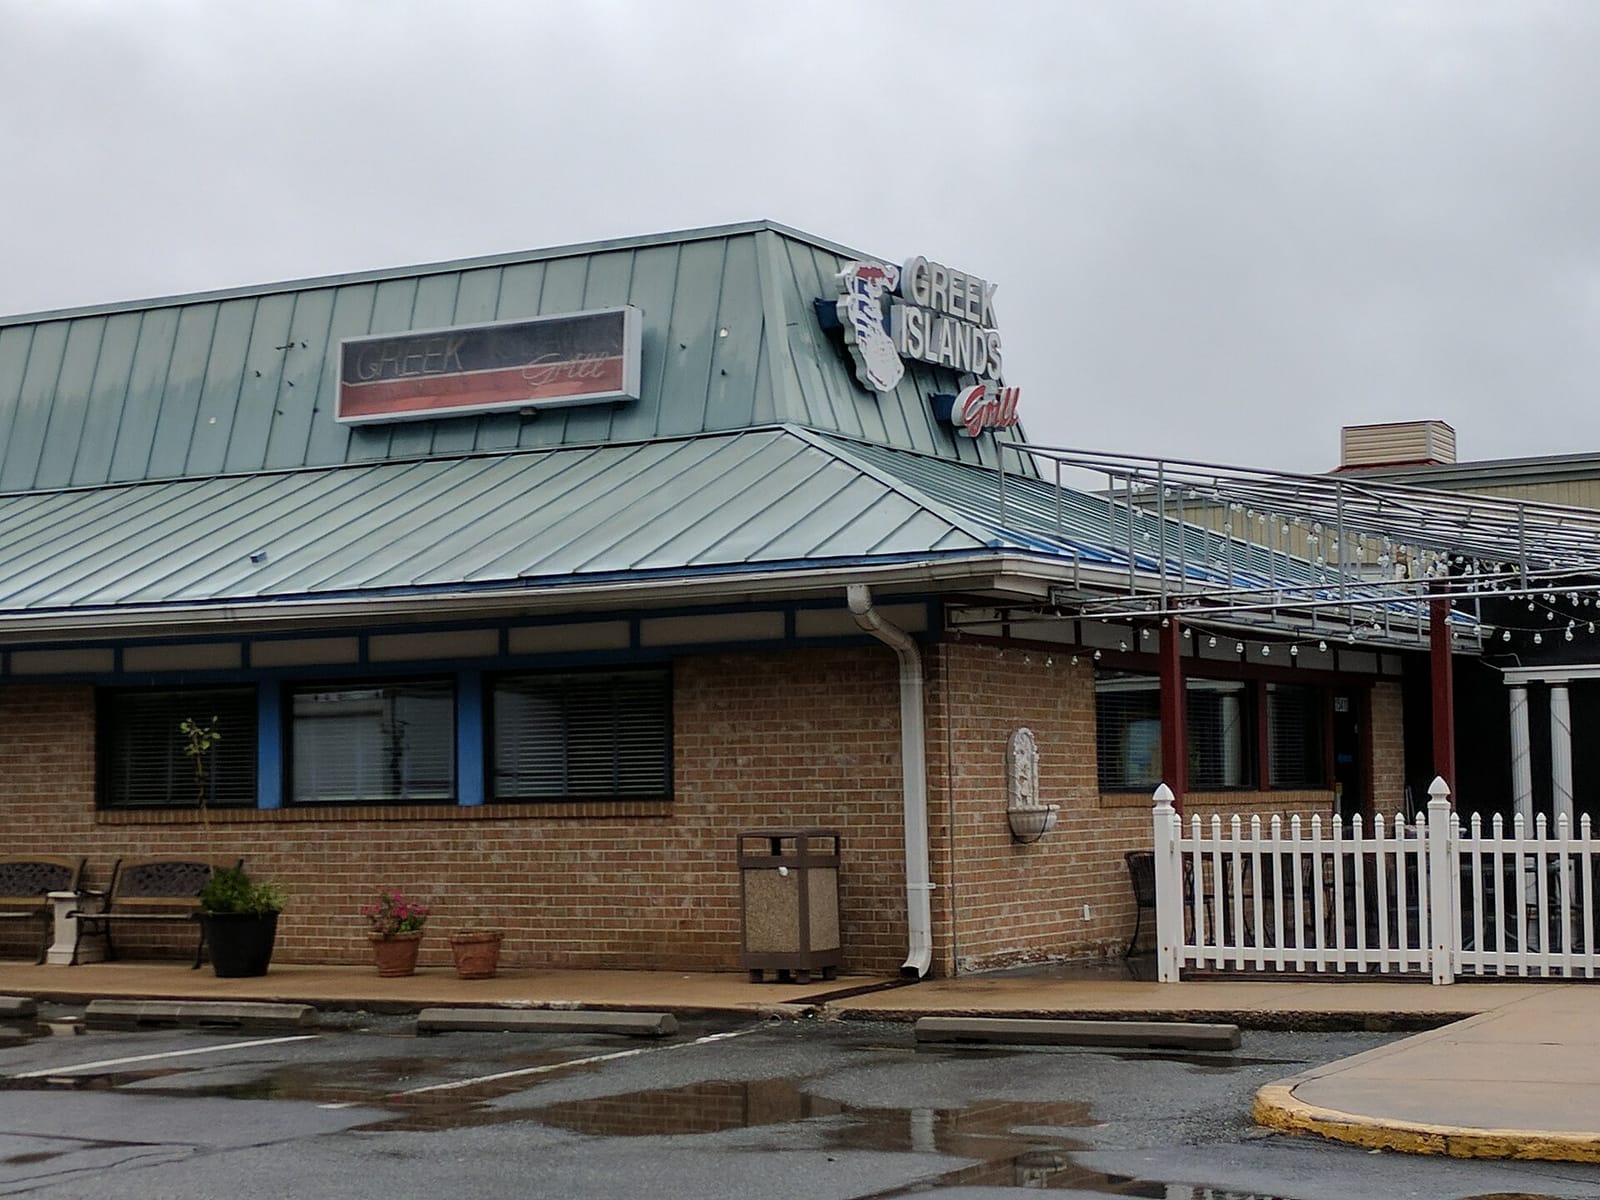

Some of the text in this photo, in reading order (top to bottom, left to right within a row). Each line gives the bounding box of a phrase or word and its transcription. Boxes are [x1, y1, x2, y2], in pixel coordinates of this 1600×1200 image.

[909, 256, 999, 331] GREEK
[357, 338, 465, 381] GREEK
[900, 304, 1003, 380] ISLANDS
[522, 350, 611, 388] Grill
[956, 385, 1020, 437] Grill
